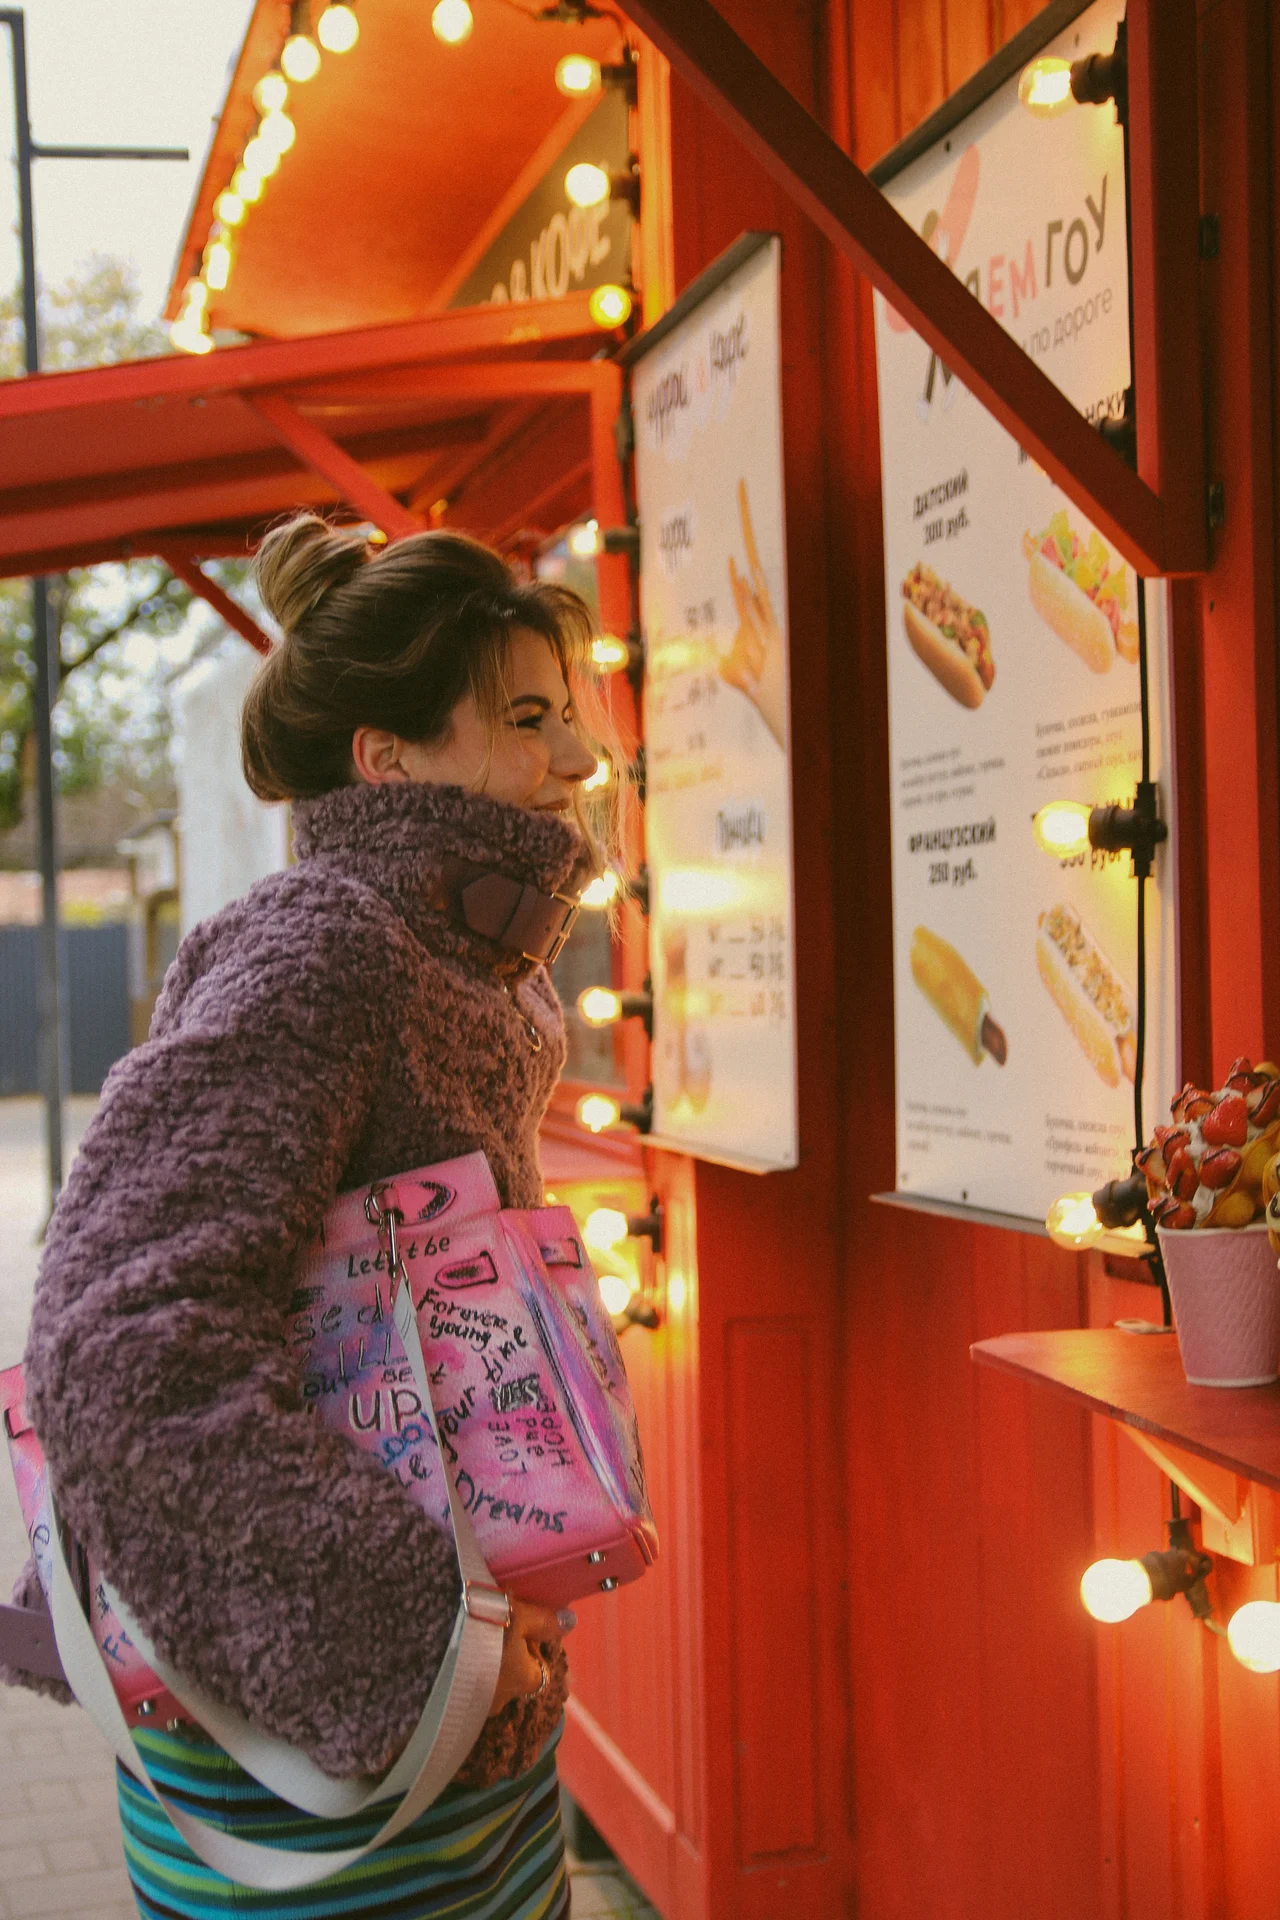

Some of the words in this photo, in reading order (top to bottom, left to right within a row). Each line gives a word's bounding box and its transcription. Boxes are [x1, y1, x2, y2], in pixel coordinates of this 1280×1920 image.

[347, 1249, 386, 1278] Let
[424, 1235, 451, 1257] be
[430, 1314, 492, 1353] young
[443, 1468, 568, 1534] Dreams
